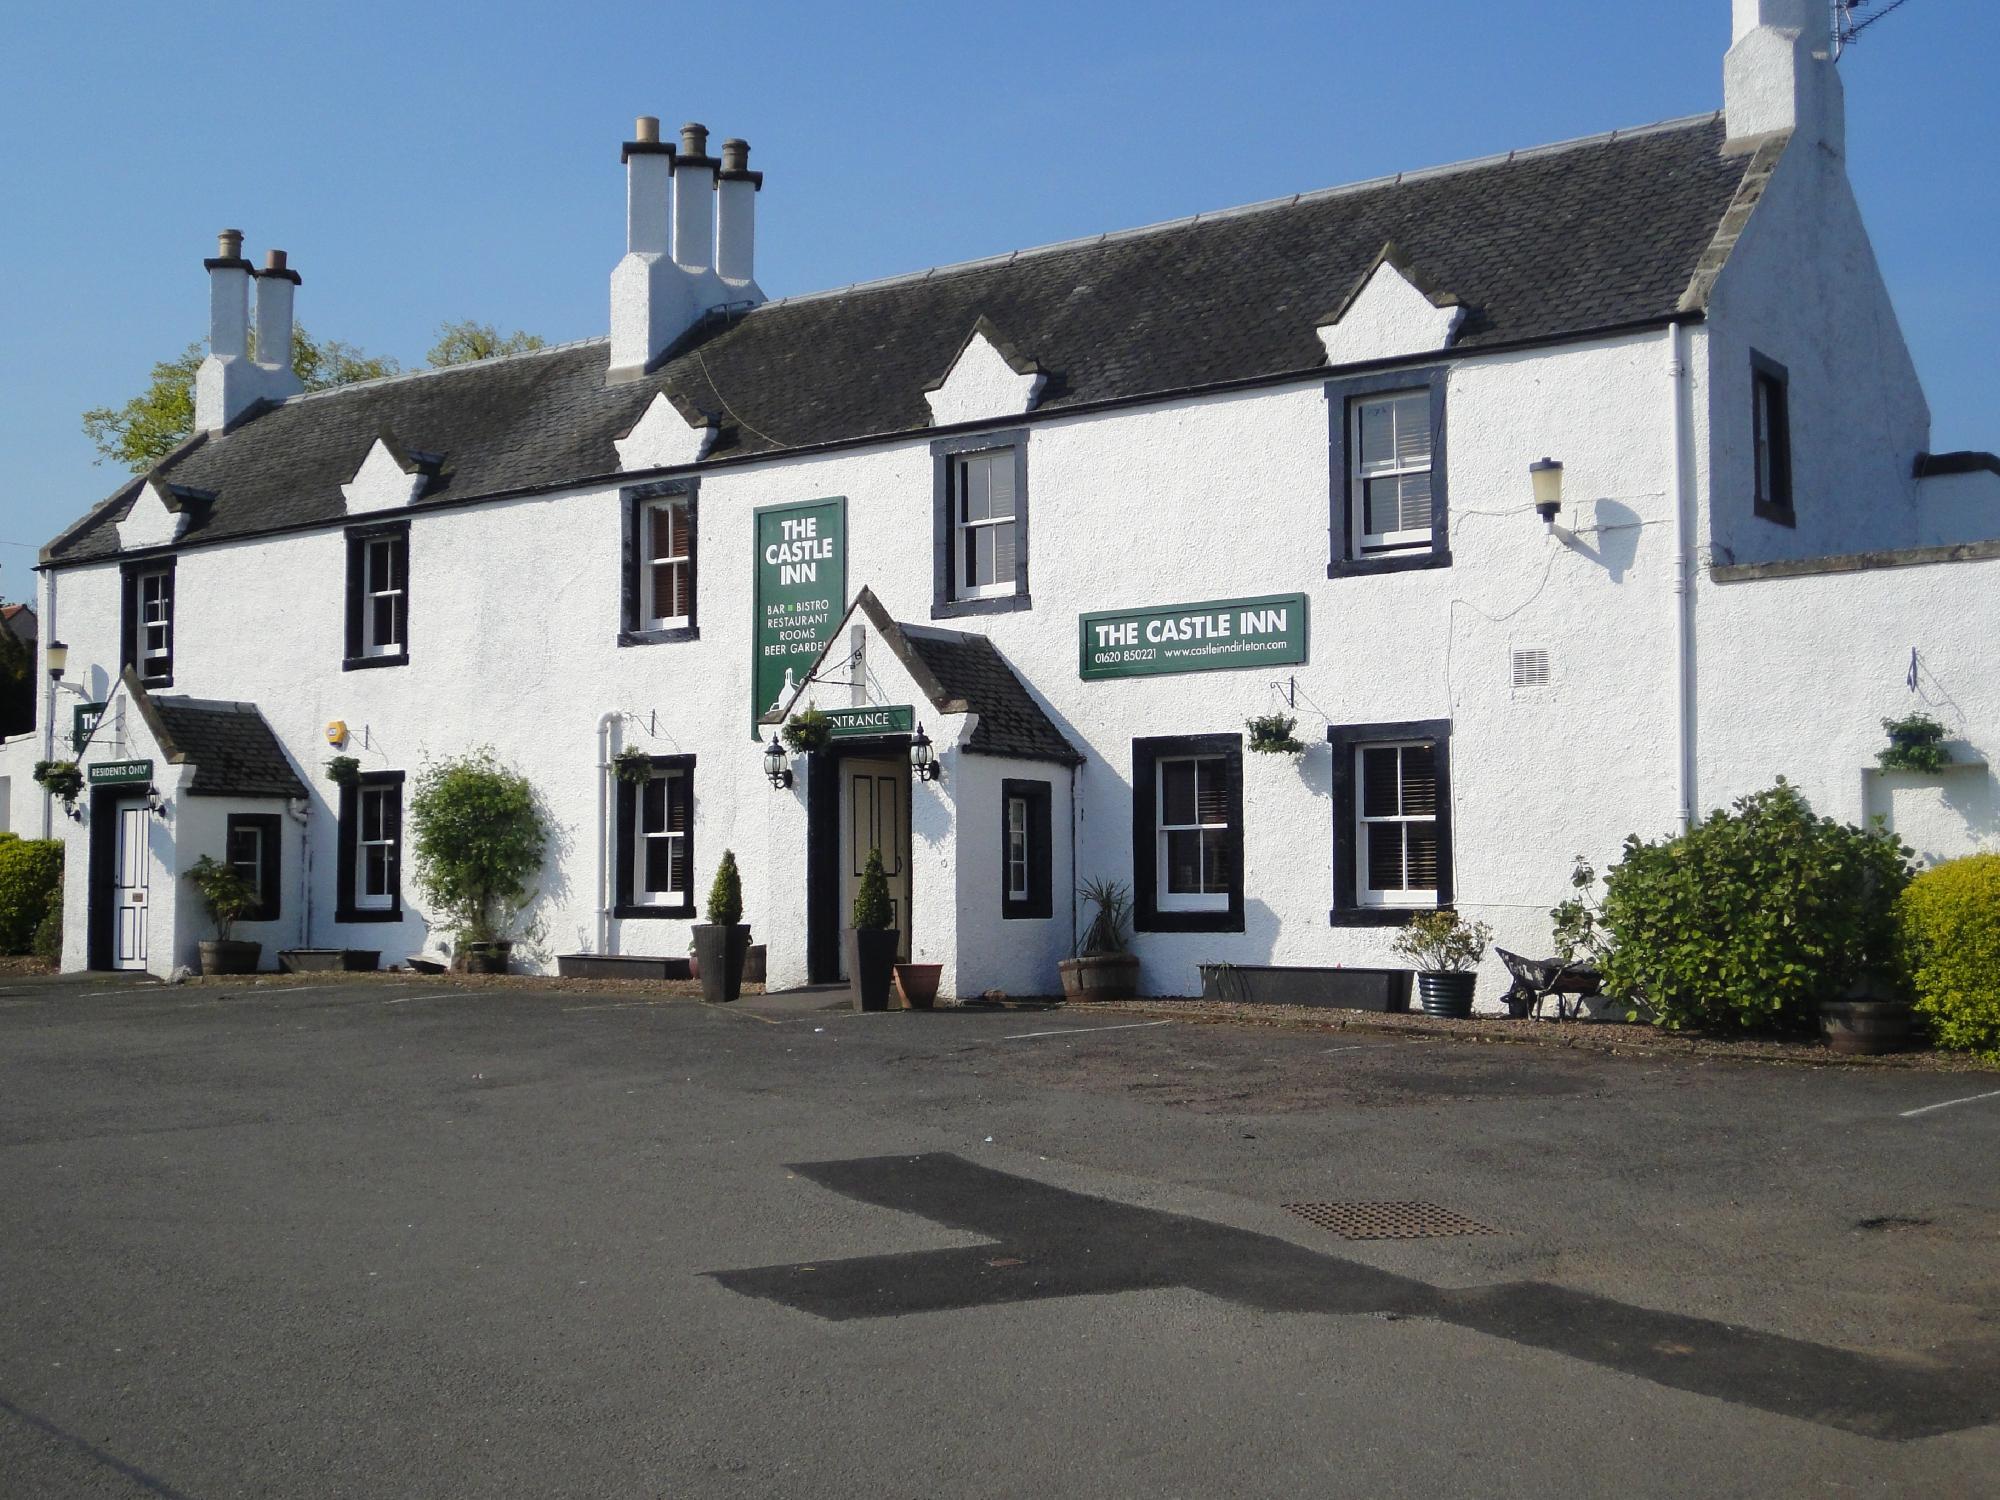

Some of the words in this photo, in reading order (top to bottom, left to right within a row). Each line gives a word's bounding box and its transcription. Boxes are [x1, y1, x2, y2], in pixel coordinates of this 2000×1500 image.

[781, 517, 816, 540] THE
[765, 538, 833, 565] CASTLE
[781, 562, 816, 585] INN
[767, 604, 785, 615] BAR
[796, 599, 829, 612] BISTRO
[767, 613, 828, 629] RESTAURANT
[1095, 622, 1138, 647] THE
[1146, 613, 1231, 643] CASTLE
[1240, 608, 1287, 635] INN
[780, 628, 816, 641] ROOMS
[764, 644, 786, 656] BEER
[790, 641, 826, 654] GARDE
[1095, 651, 1121, 664] 01620
[1123, 648, 1156, 661] 850221
[1164, 639, 1287, 658] www.castleinndirleton.com
[92, 766, 127, 777] RESIDENTS
[128, 764, 147, 776] ONLY
